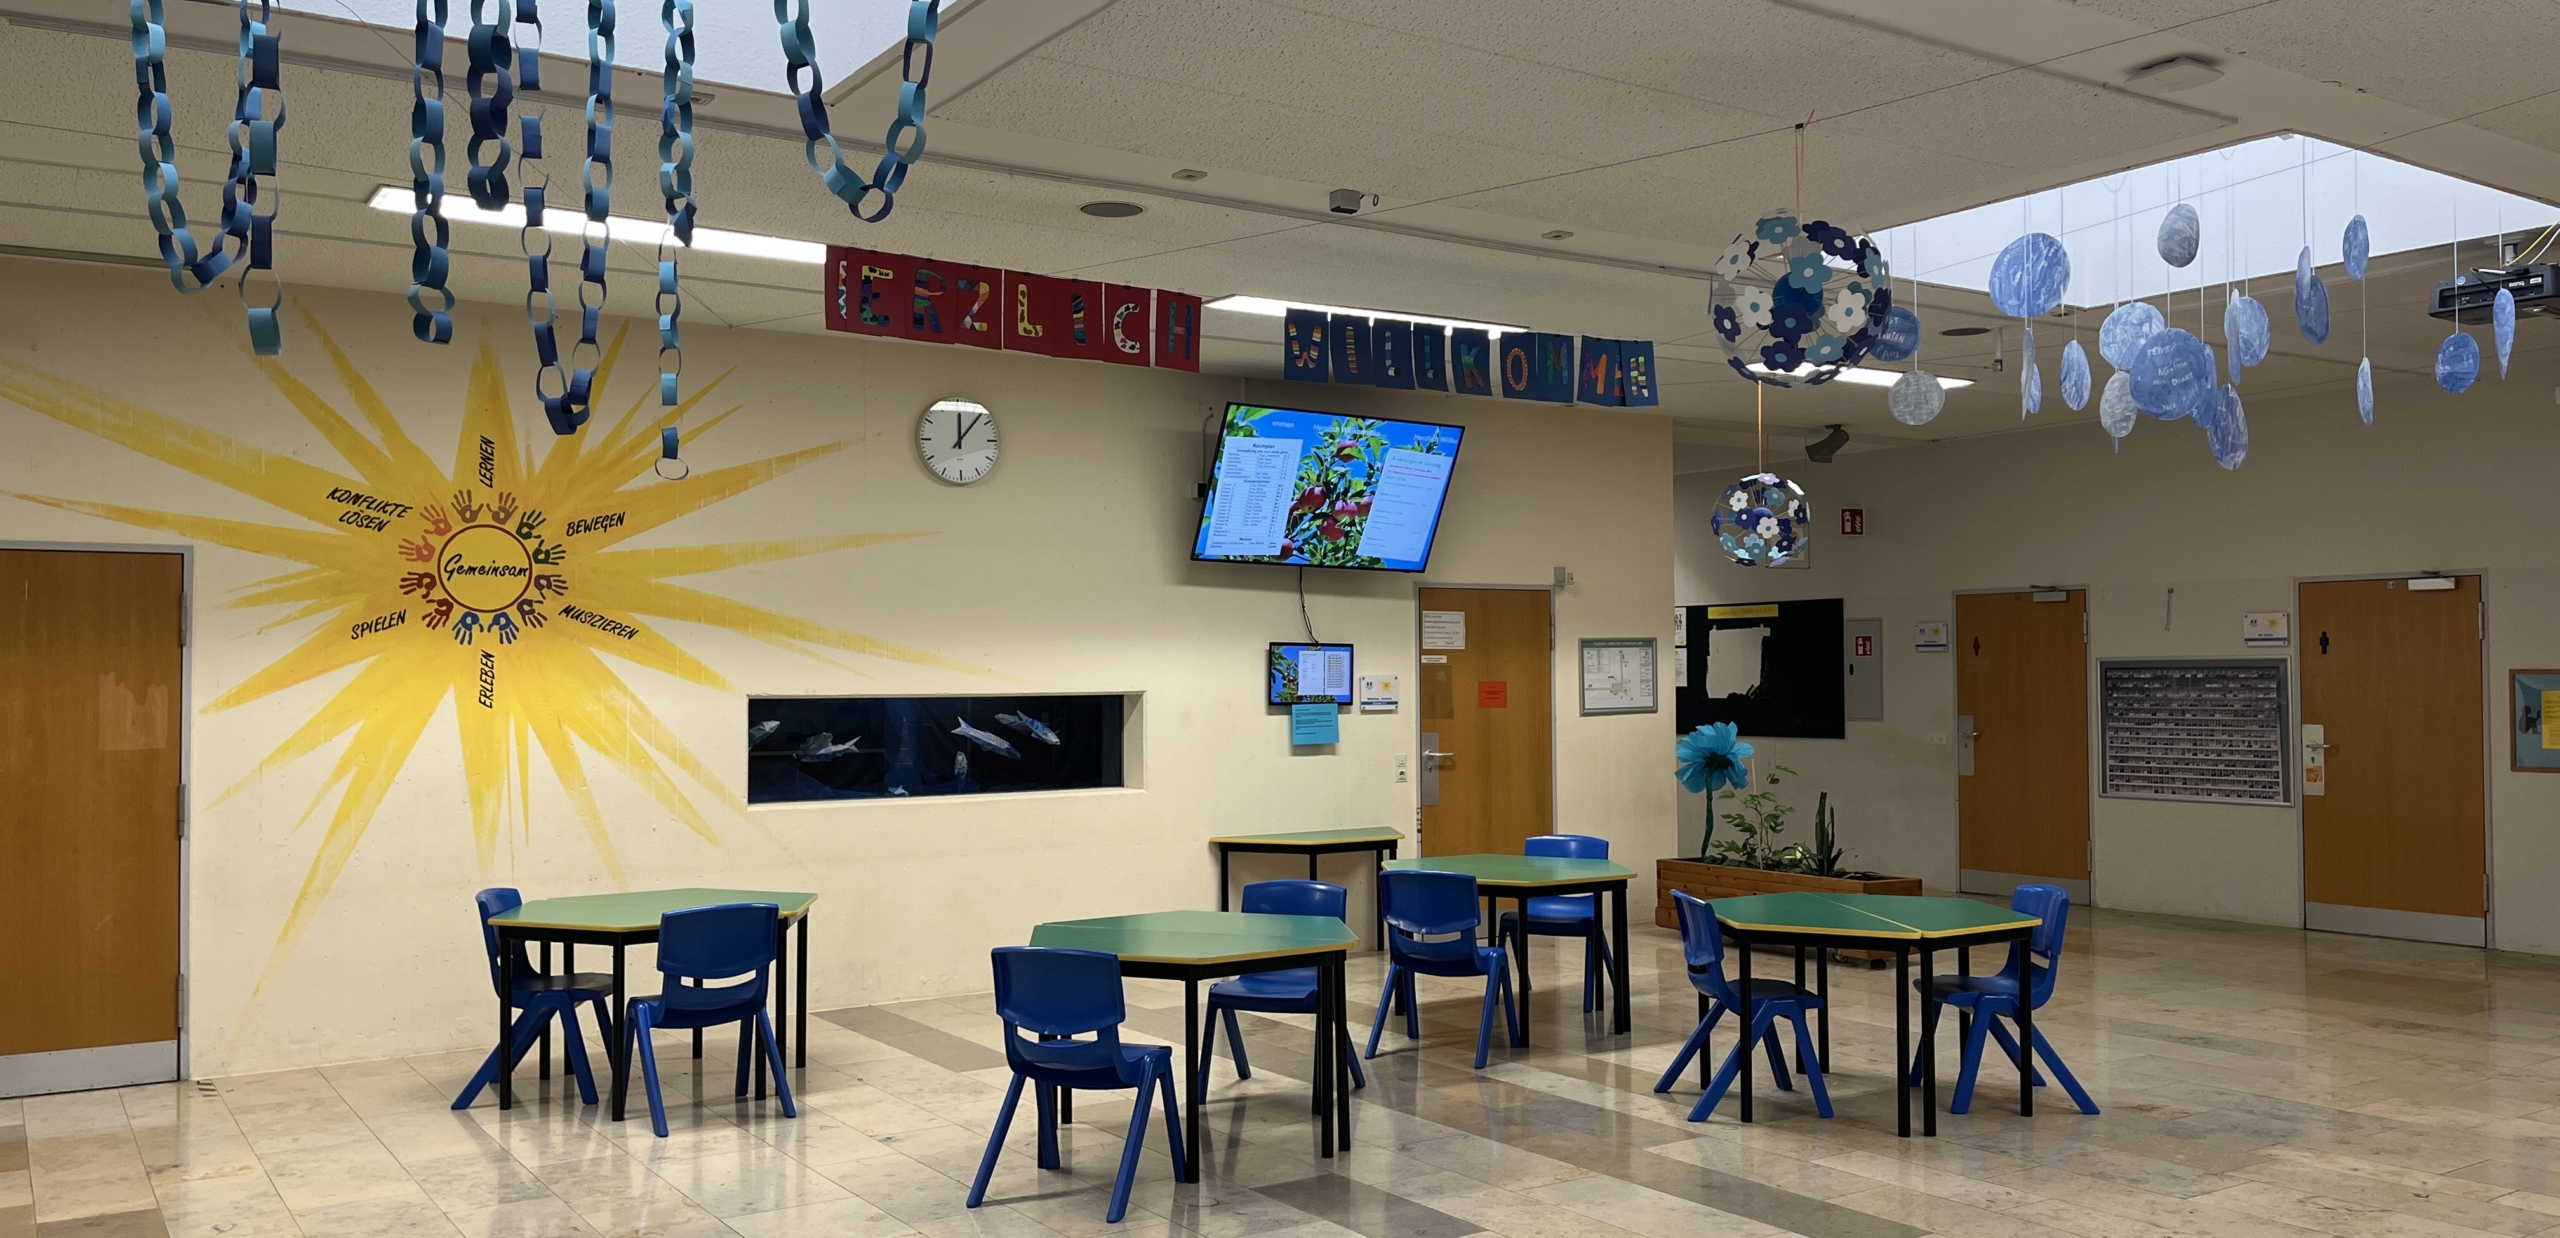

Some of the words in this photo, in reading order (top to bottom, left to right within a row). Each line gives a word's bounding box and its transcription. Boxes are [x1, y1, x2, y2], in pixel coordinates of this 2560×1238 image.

[479, 435, 496, 488] LERNEN
[326, 487, 413, 519] KONFLIKTE
[338, 508, 391, 534] LÖSEN
[565, 511, 626, 537] BEWEGEN
[443, 553, 529, 582] Gemeinsam
[350, 610, 407, 640] SPIELEN
[558, 604, 639, 641] MUSIZIEREN
[479, 649, 496, 709] ERLEBEN
